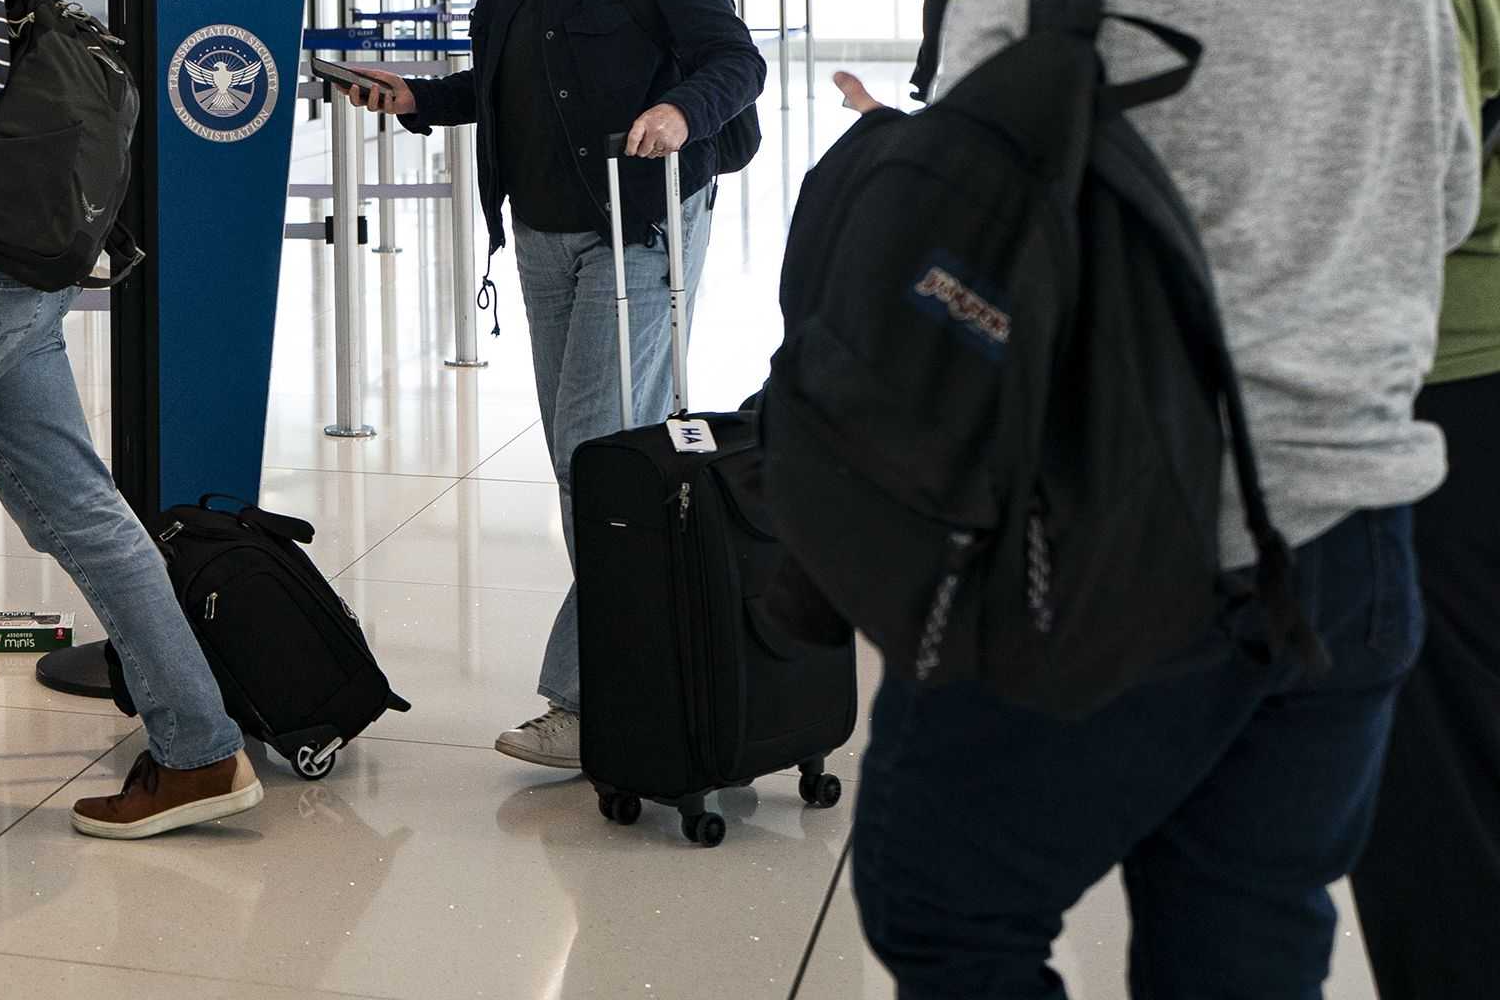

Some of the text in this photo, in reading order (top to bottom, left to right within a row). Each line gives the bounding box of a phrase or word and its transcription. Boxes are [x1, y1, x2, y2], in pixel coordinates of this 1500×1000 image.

[169, 26, 278, 91] TRANSPORTATION SECURITY
[174, 106, 270, 140] ADMINISTRATION
[4, 638, 35, 648] minis
